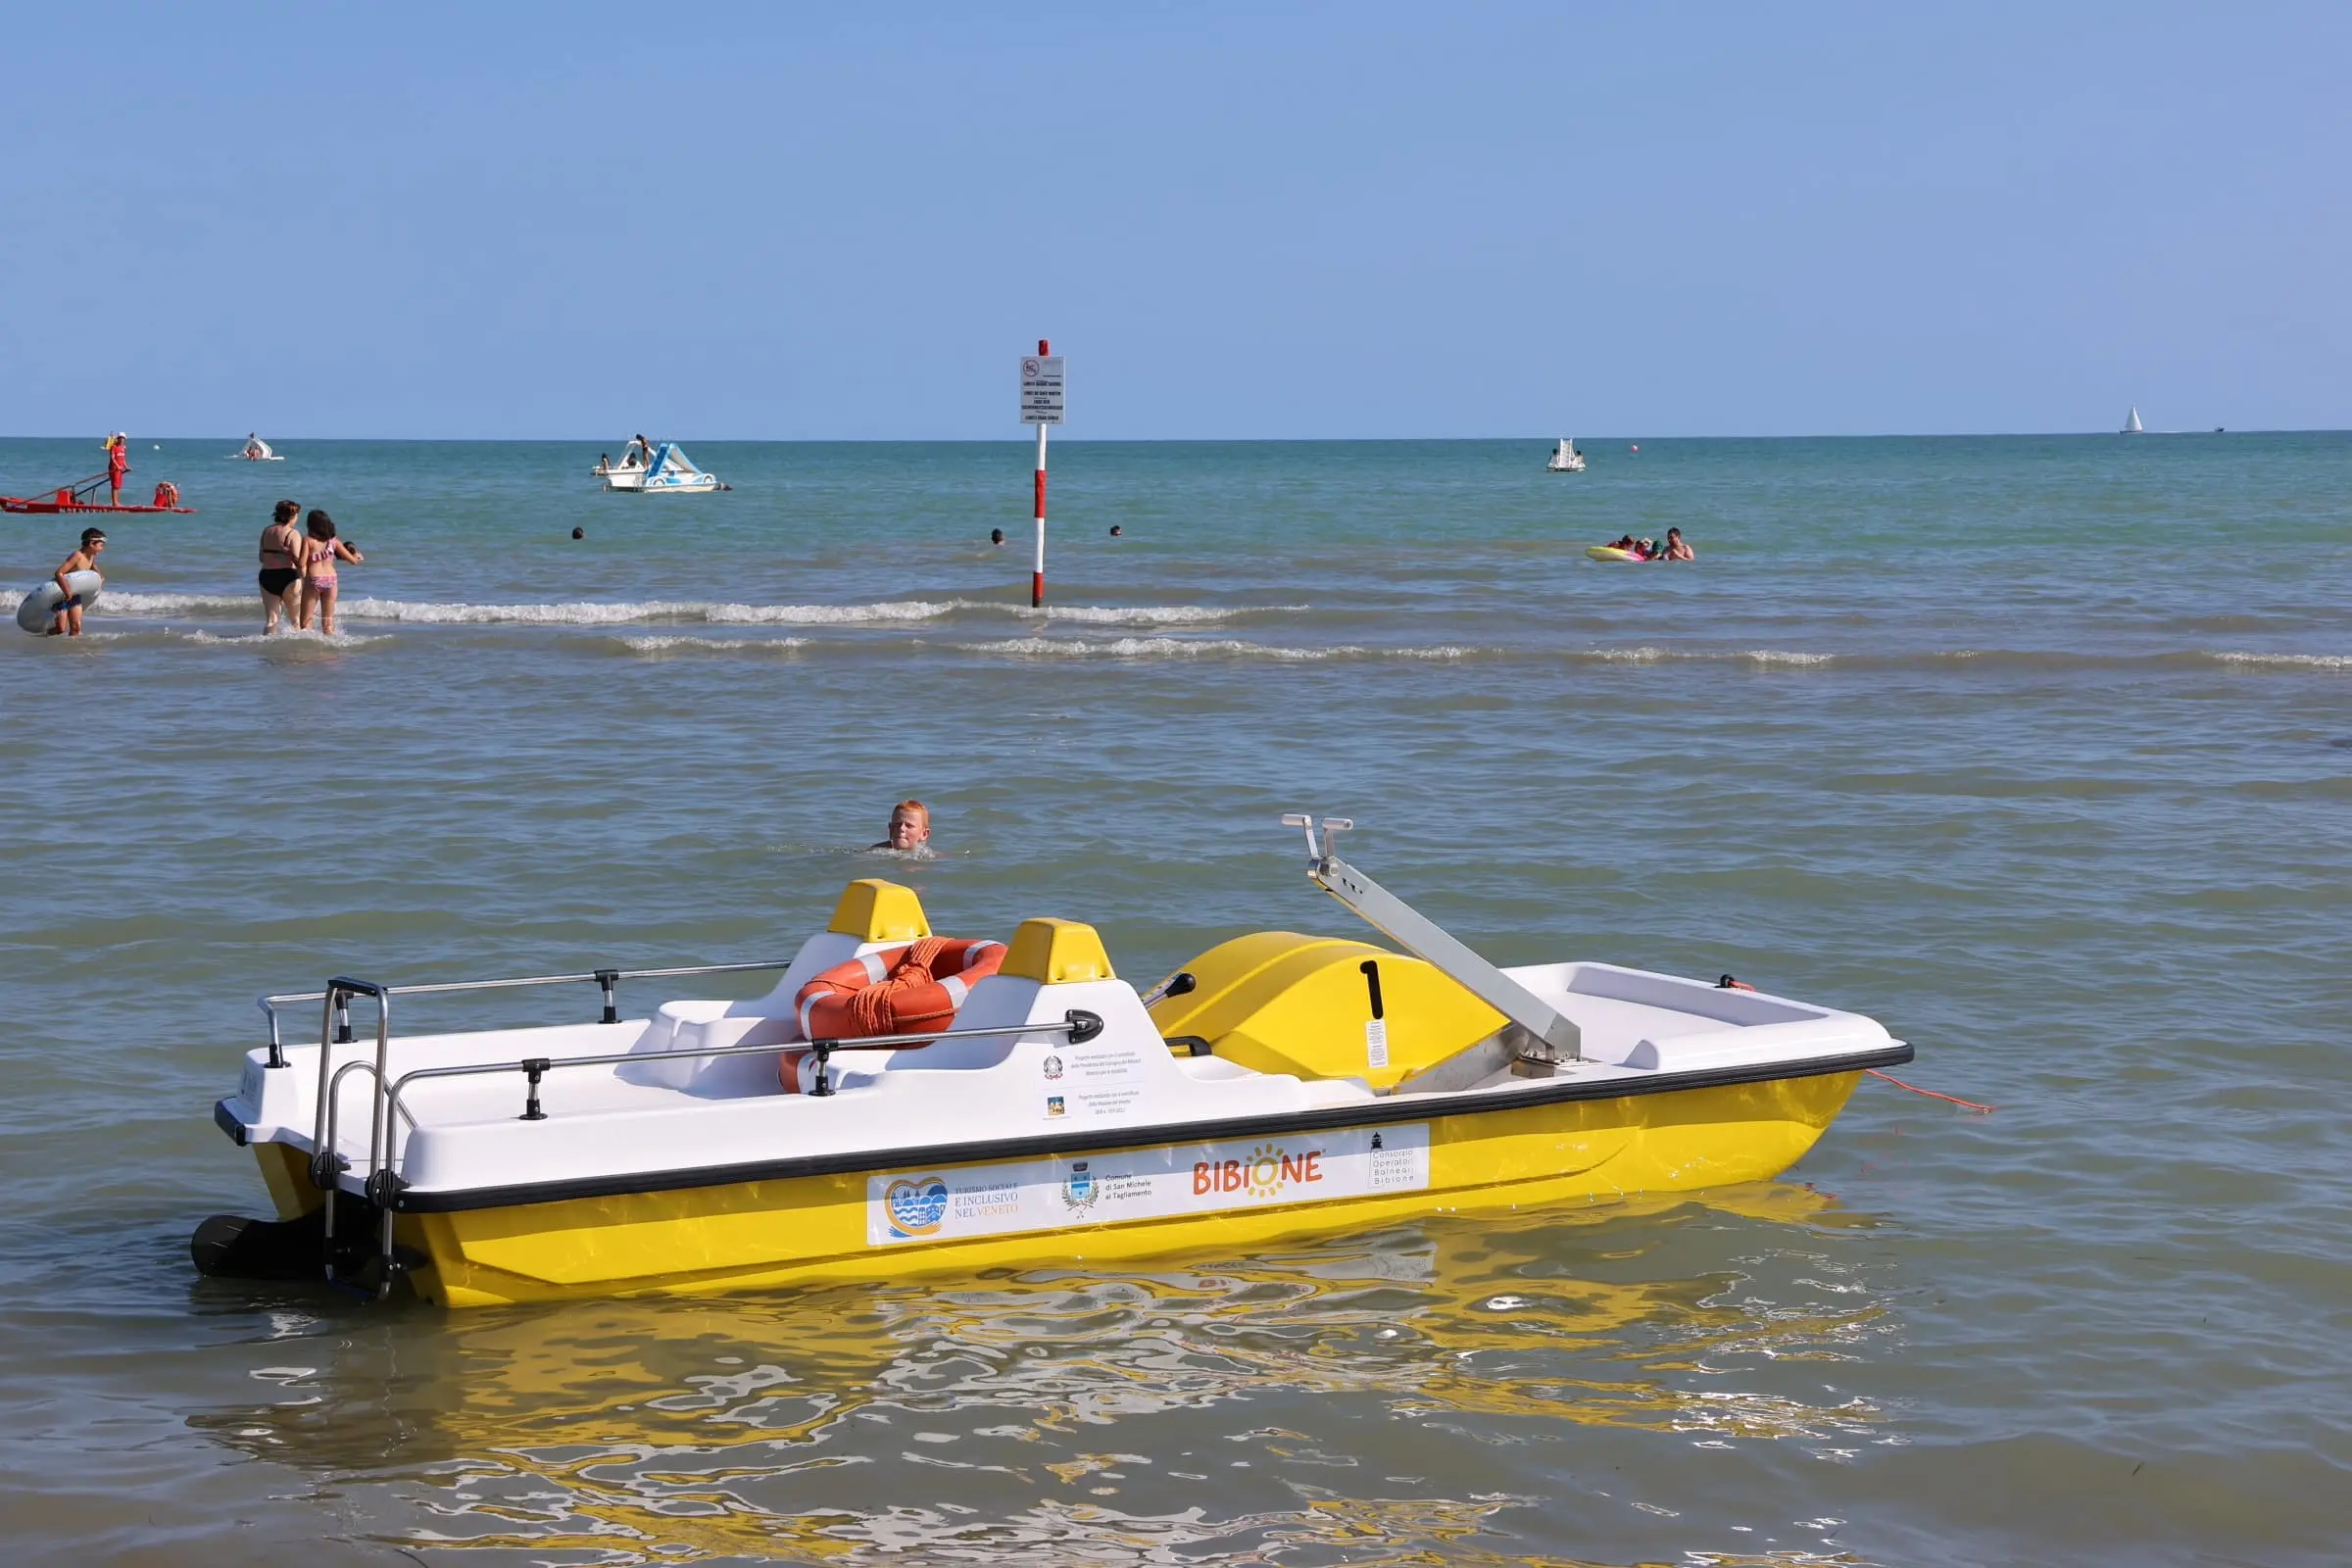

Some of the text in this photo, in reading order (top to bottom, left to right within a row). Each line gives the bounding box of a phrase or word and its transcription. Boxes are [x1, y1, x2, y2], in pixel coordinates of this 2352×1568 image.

[1359, 959, 1384, 1020] 1
[1373, 1149, 1413, 1158] Consorzio
[1373, 1158, 1413, 1168] Operatori
[1374, 1167, 1414, 1176] Balneari
[1127, 1179, 1152, 1188] Michele
[1374, 1175, 1414, 1185] Bibione
[956, 1192, 1018, 1206] E INCLUSIVO
[1113, 1190, 1152, 1200] Tagliamento
[955, 1203, 1018, 1219] NEL VENETO
